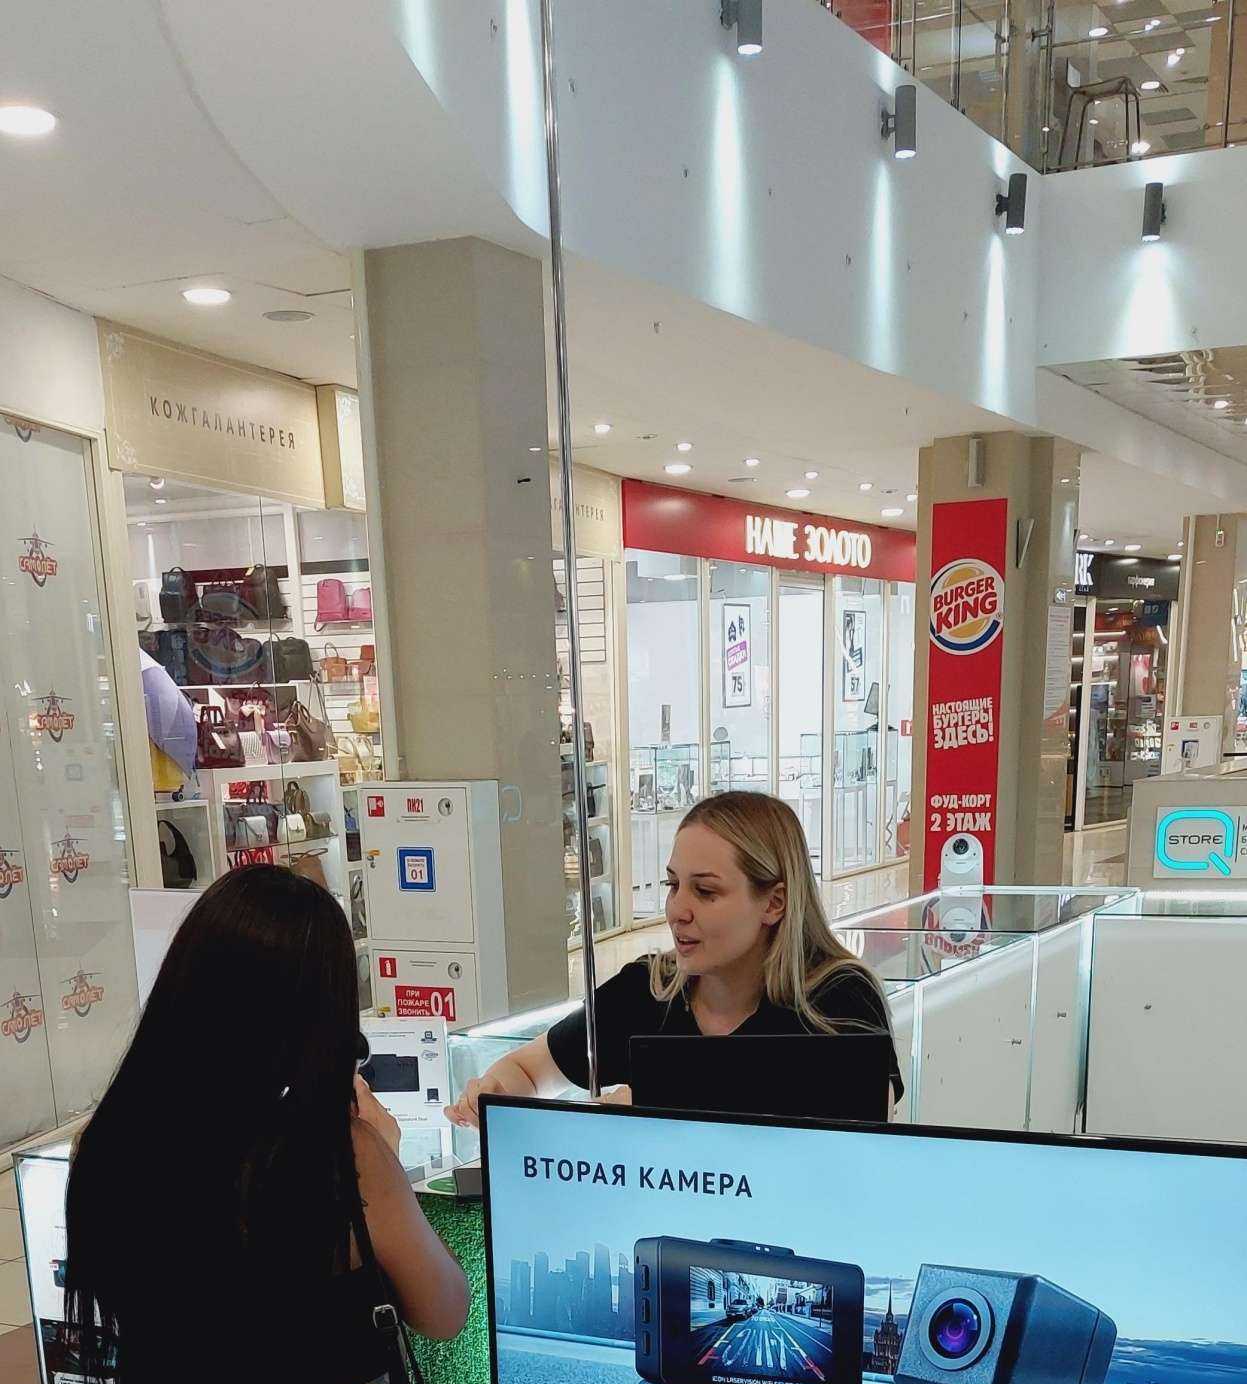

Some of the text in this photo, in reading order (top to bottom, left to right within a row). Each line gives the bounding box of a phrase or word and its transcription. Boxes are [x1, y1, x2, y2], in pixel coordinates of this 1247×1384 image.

[150, 396, 296, 450] КОЖГАЛАНТЕРЕЯ
[745, 515, 871, 568] НАШЕ ЗОЛОТО
[933, 576, 995, 613] BURGER
[936, 592, 998, 634] KING
[932, 697, 993, 716] НАСТОЯЩИЕ
[933, 708, 992, 729] БУРГЕРЫ
[934, 723, 994, 750] ЗДЕСЬ!
[930, 794, 991, 809] ФУД-КОРТ
[930, 812, 992, 832] 2 ЭТАЖ
[1168, 835, 1223, 845] STORE
[411, 869, 423, 881] 01
[397, 999, 430, 1007] ПОЖАРЕ
[406, 990, 420, 998] ПРИ
[398, 1008, 430, 1016] ЗВОНИТЬ
[431, 991, 454, 1018] 01
[523, 1156, 753, 1198] ВТОРАЯ КАМЕРА
